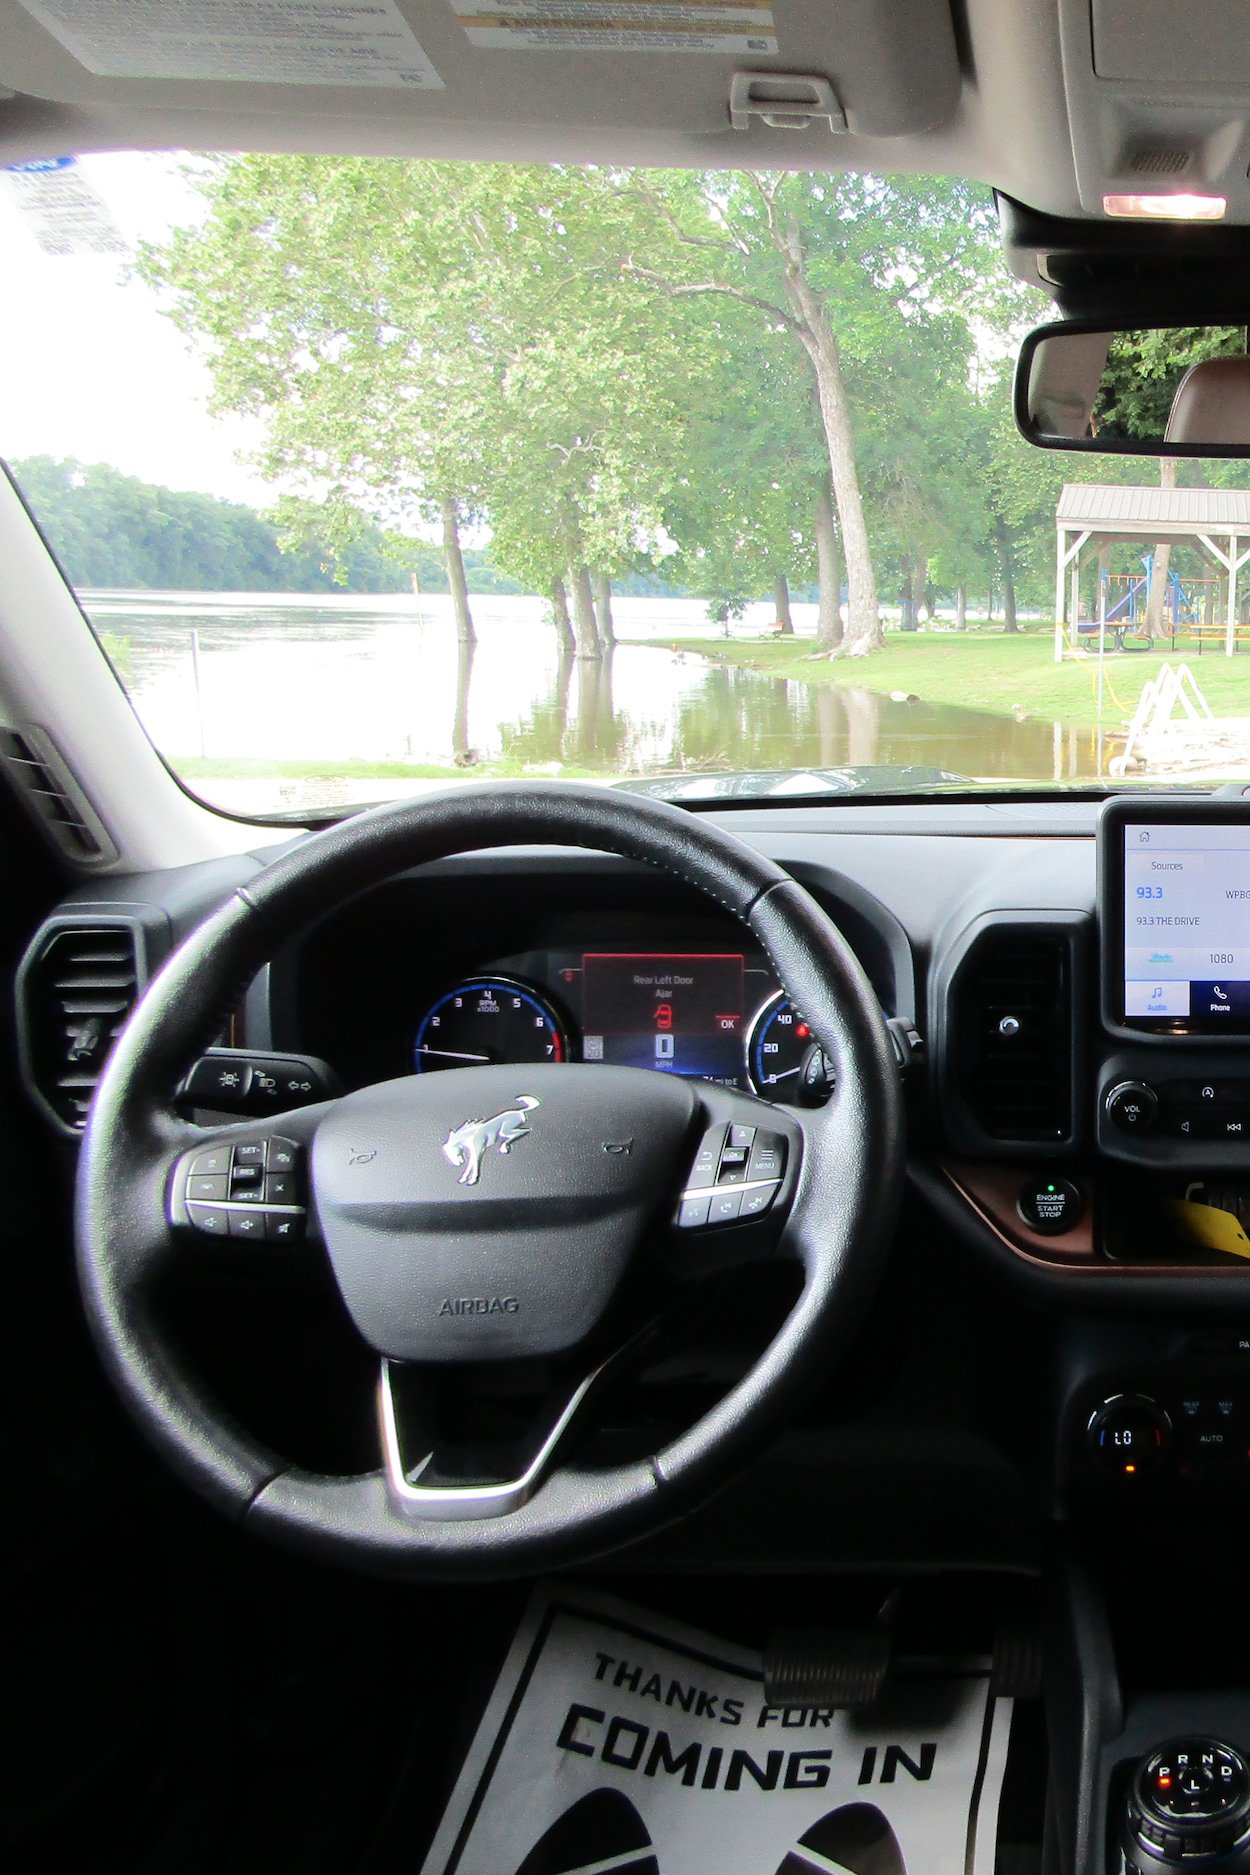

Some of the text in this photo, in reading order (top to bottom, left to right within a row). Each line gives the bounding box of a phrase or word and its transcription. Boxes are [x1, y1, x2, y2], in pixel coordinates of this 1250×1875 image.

[1151, 861, 1183, 871] Sources
[1136, 886, 1163, 899] 93.3
[1136, 916, 1200, 926] 93.3 THE DRIVE
[1210, 953, 1234, 964] 1080
[633, 975, 694, 984] Rear Left Door
[483, 991, 492, 1000] 4
[655, 989, 673, 999] Ajar
[455, 998, 463, 1008] 3
[513, 998, 521, 1008] 5
[1147, 1003, 1167, 1011] Audio
[1210, 1003, 1230, 1011] Phone
[432, 1017, 440, 1026] 2
[536, 1018, 544, 1027] 6
[721, 1020, 735, 1029] OK
[778, 1015, 792, 1024] 40
[547, 1045, 554, 1055] 7
[655, 1034, 674, 1058] 0
[763, 1043, 779, 1053] 20
[439, 1297, 519, 1316] AIRBAG
[1200, 1434, 1223, 1442] AUTO
[595, 1652, 834, 1728] THANKS FOR
[556, 1703, 937, 1791] COMING IN
[1177, 1754, 1214, 1764] R N
[1159, 1766, 1171, 1777] P
[1221, 1765, 1233, 1776] D
[1190, 1779, 1200, 1790] L
